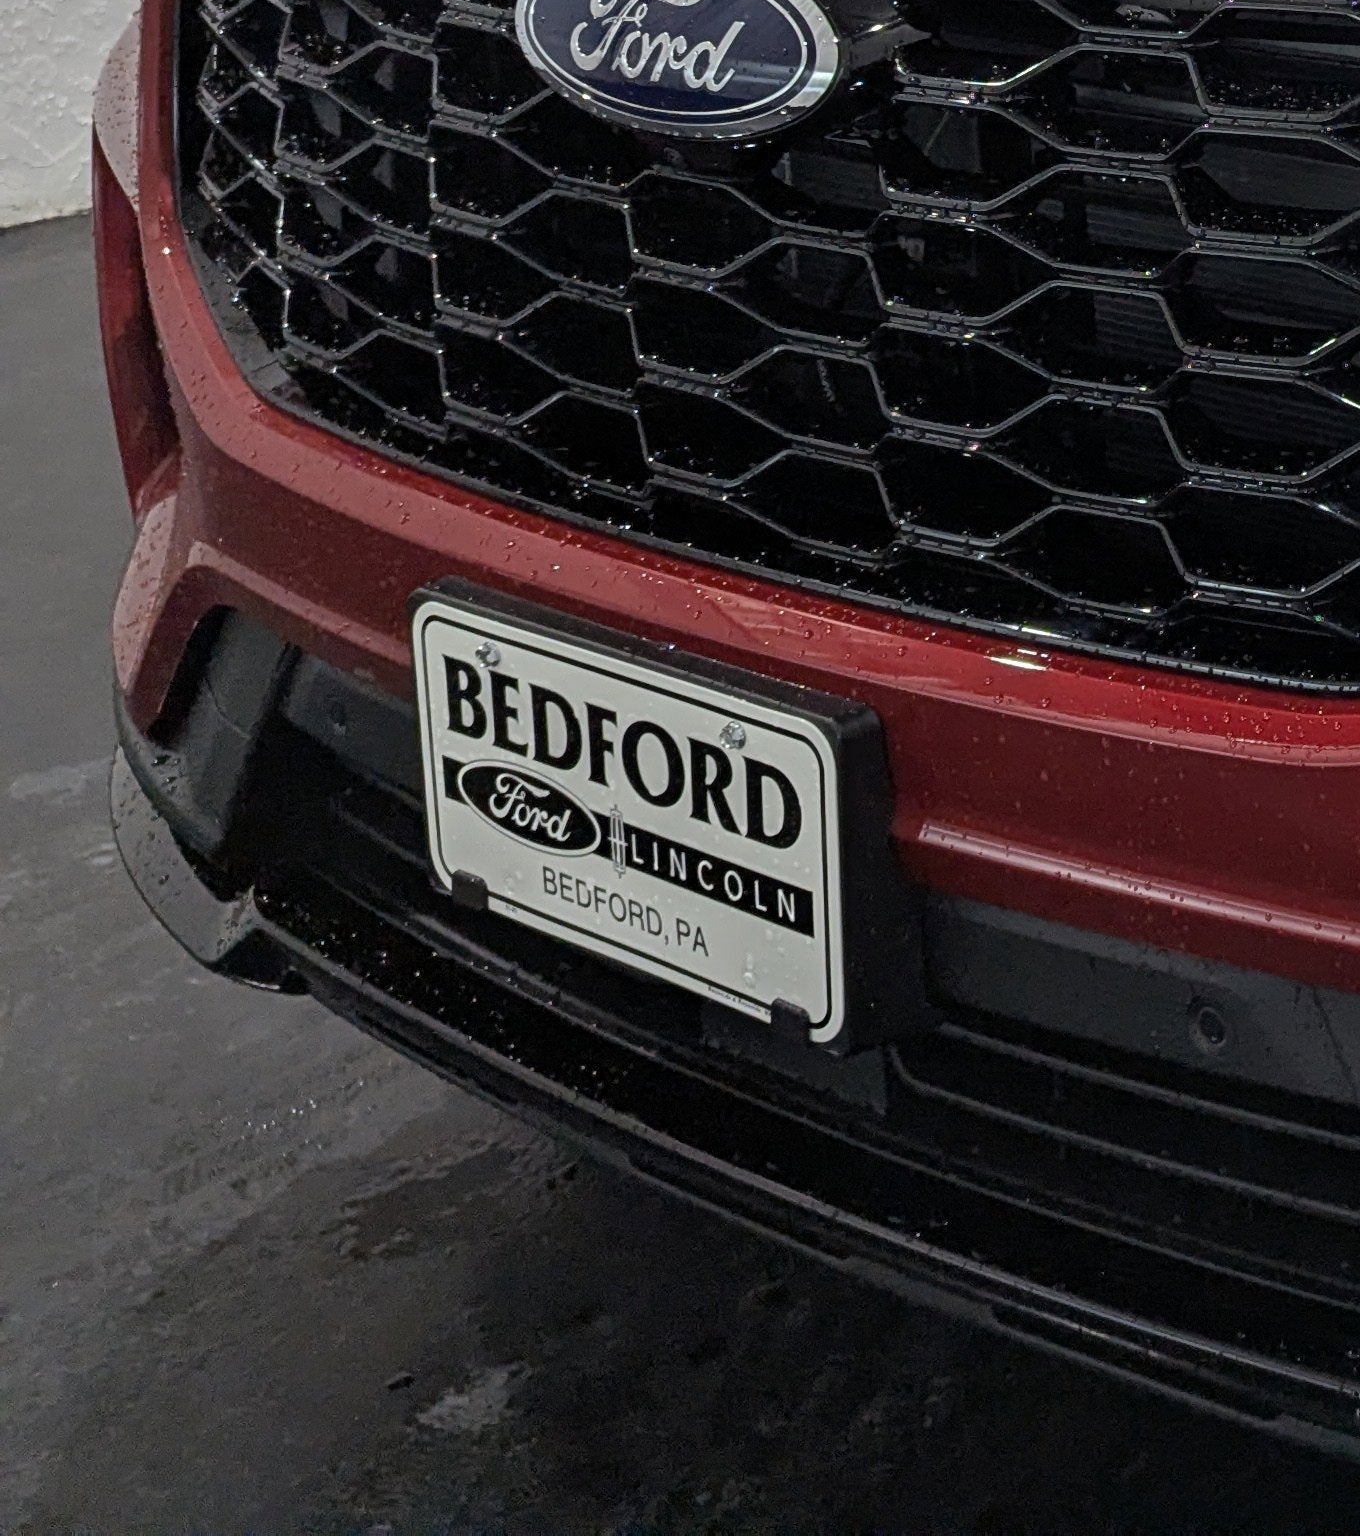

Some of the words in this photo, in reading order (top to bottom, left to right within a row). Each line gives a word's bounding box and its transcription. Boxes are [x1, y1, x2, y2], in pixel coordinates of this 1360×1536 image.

[442, 654, 802, 849] BEDFORD
[488, 772, 572, 842] Ford
[632, 833, 797, 924] LINCOLN
[542, 866, 670, 946] BEDFORD,
[676, 917, 709, 957] PA
